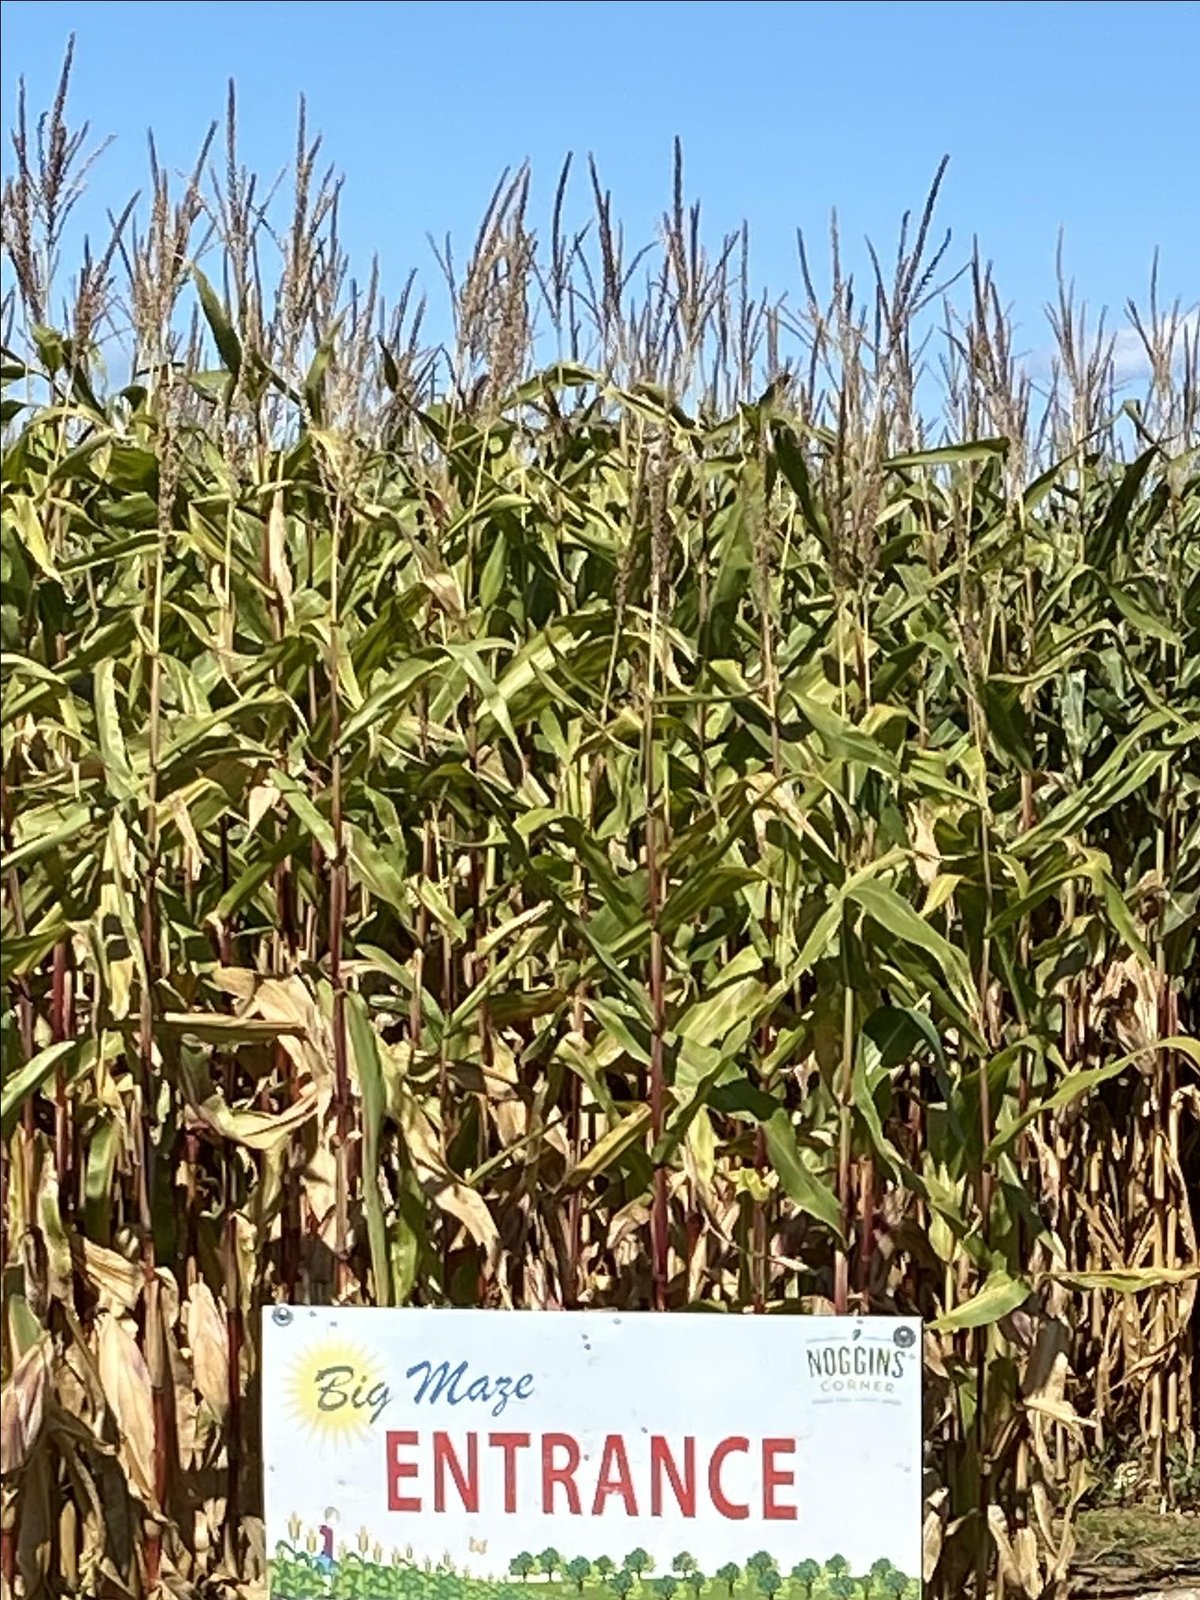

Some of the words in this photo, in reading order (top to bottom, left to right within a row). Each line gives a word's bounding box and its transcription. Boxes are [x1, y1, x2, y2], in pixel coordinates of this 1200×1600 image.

[806, 1346, 904, 1378] NOGGINS
[820, 1379, 895, 1393] CORNER
[315, 1365, 391, 1424] Big
[406, 1360, 534, 1417] Maze
[385, 1430, 798, 1521] ENTRANCE
